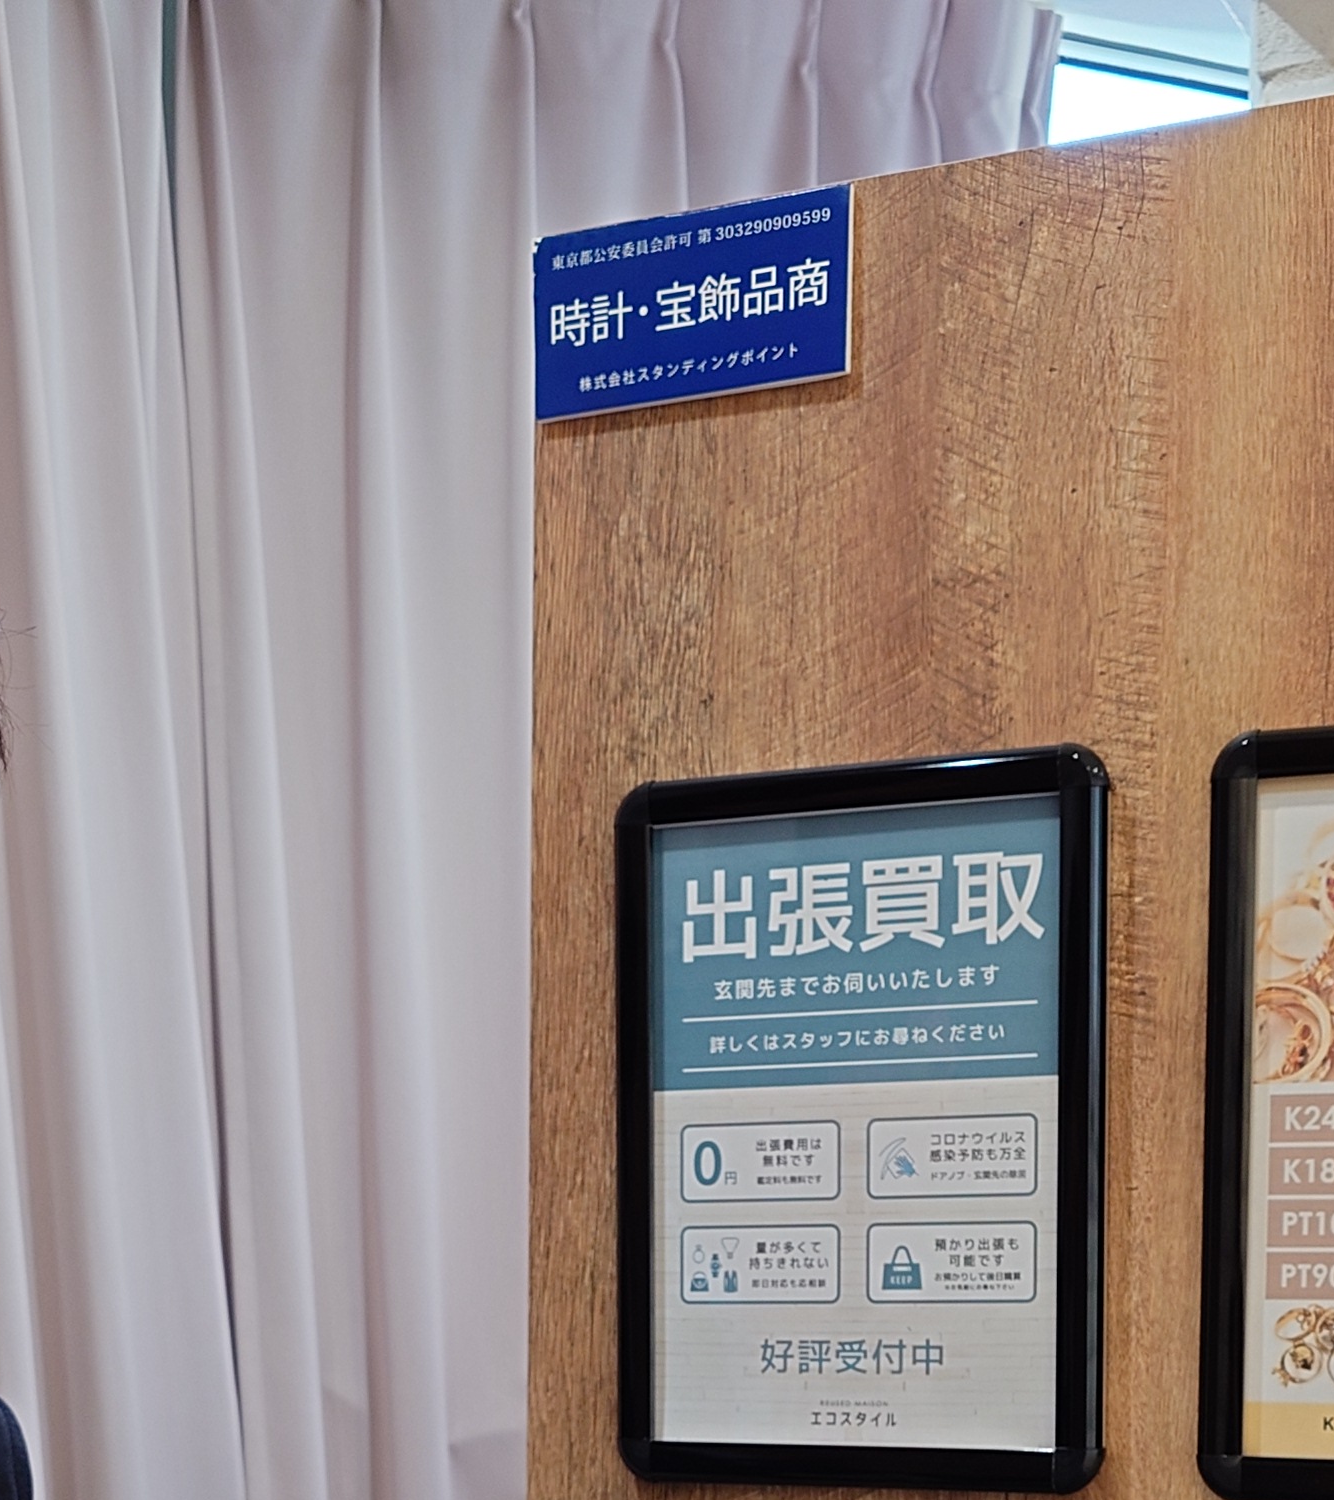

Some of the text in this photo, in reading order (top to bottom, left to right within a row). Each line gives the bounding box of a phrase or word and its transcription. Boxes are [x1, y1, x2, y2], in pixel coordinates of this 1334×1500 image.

[551, 207, 831, 271] 東京都公安委員会許可 303290909599
[550, 257, 830, 347] 時計・宝飾品商
[579, 342, 799, 393] 株式会社スタンディングポイント
[682, 851, 1046, 963] 出張買取
[714, 964, 1000, 1001] 玄関先までお伺いいたします
[709, 1023, 1006, 1054] 詳しくはスタッフにお尋ねください
[755, 1138, 822, 1152] 出張費用は
[930, 1131, 1026, 1146] コロナウイルス
[762, 1154, 815, 1167] 無料です
[935, 1238, 1019, 1251] 預かり出張も
[949, 1254, 1004, 1267] 可能です
[760, 1339, 944, 1375] 好評受付中
[811, 1411, 897, 1428] エコスタイル
